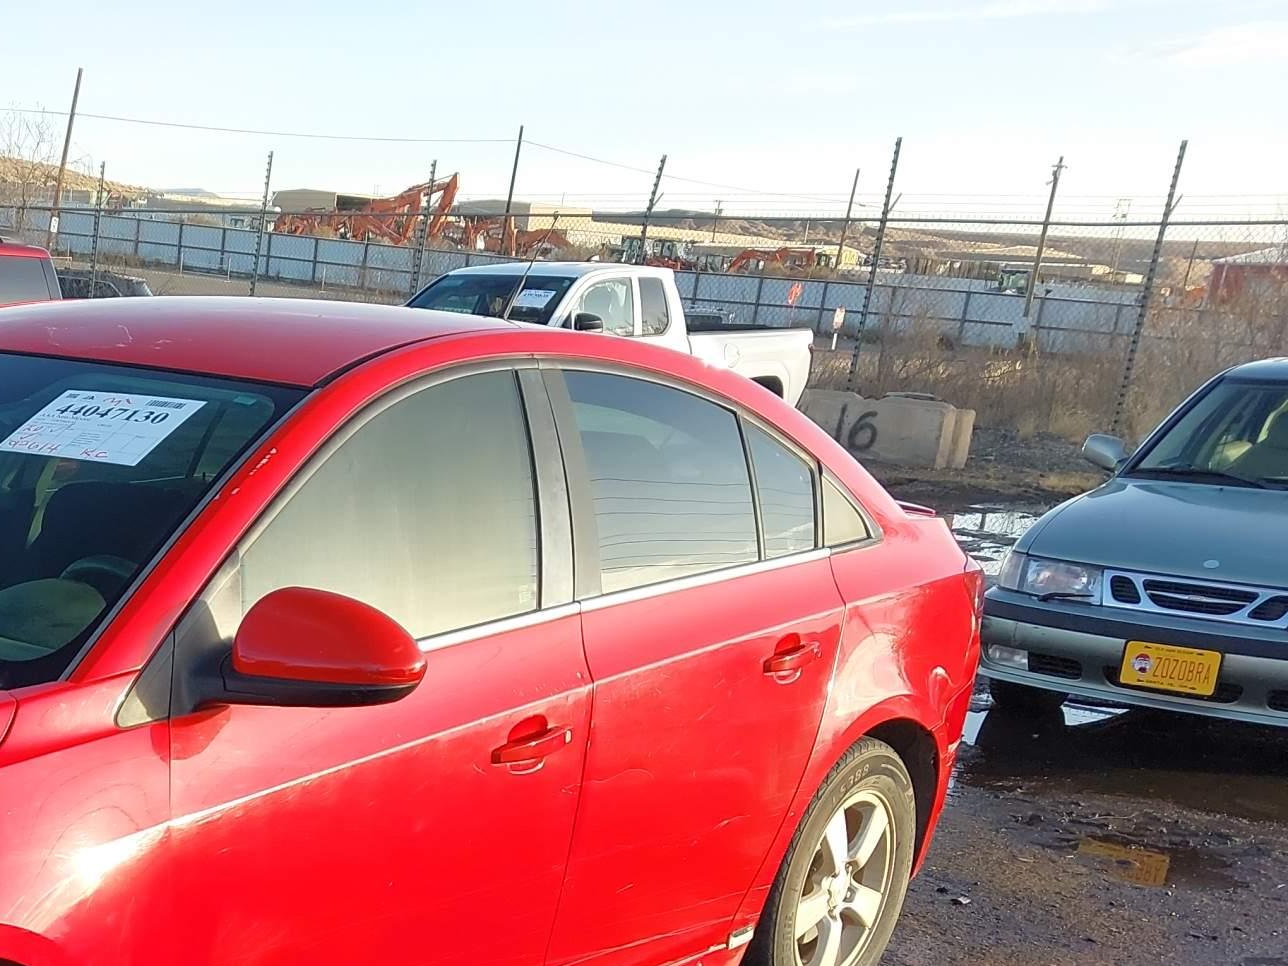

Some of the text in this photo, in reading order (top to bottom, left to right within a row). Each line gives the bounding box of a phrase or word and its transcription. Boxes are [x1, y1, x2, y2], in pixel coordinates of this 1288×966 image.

[56, 402, 170, 425] 44047130
[834, 403, 879, 451] 16
[1152, 656, 1211, 685] ZOZOBRA
